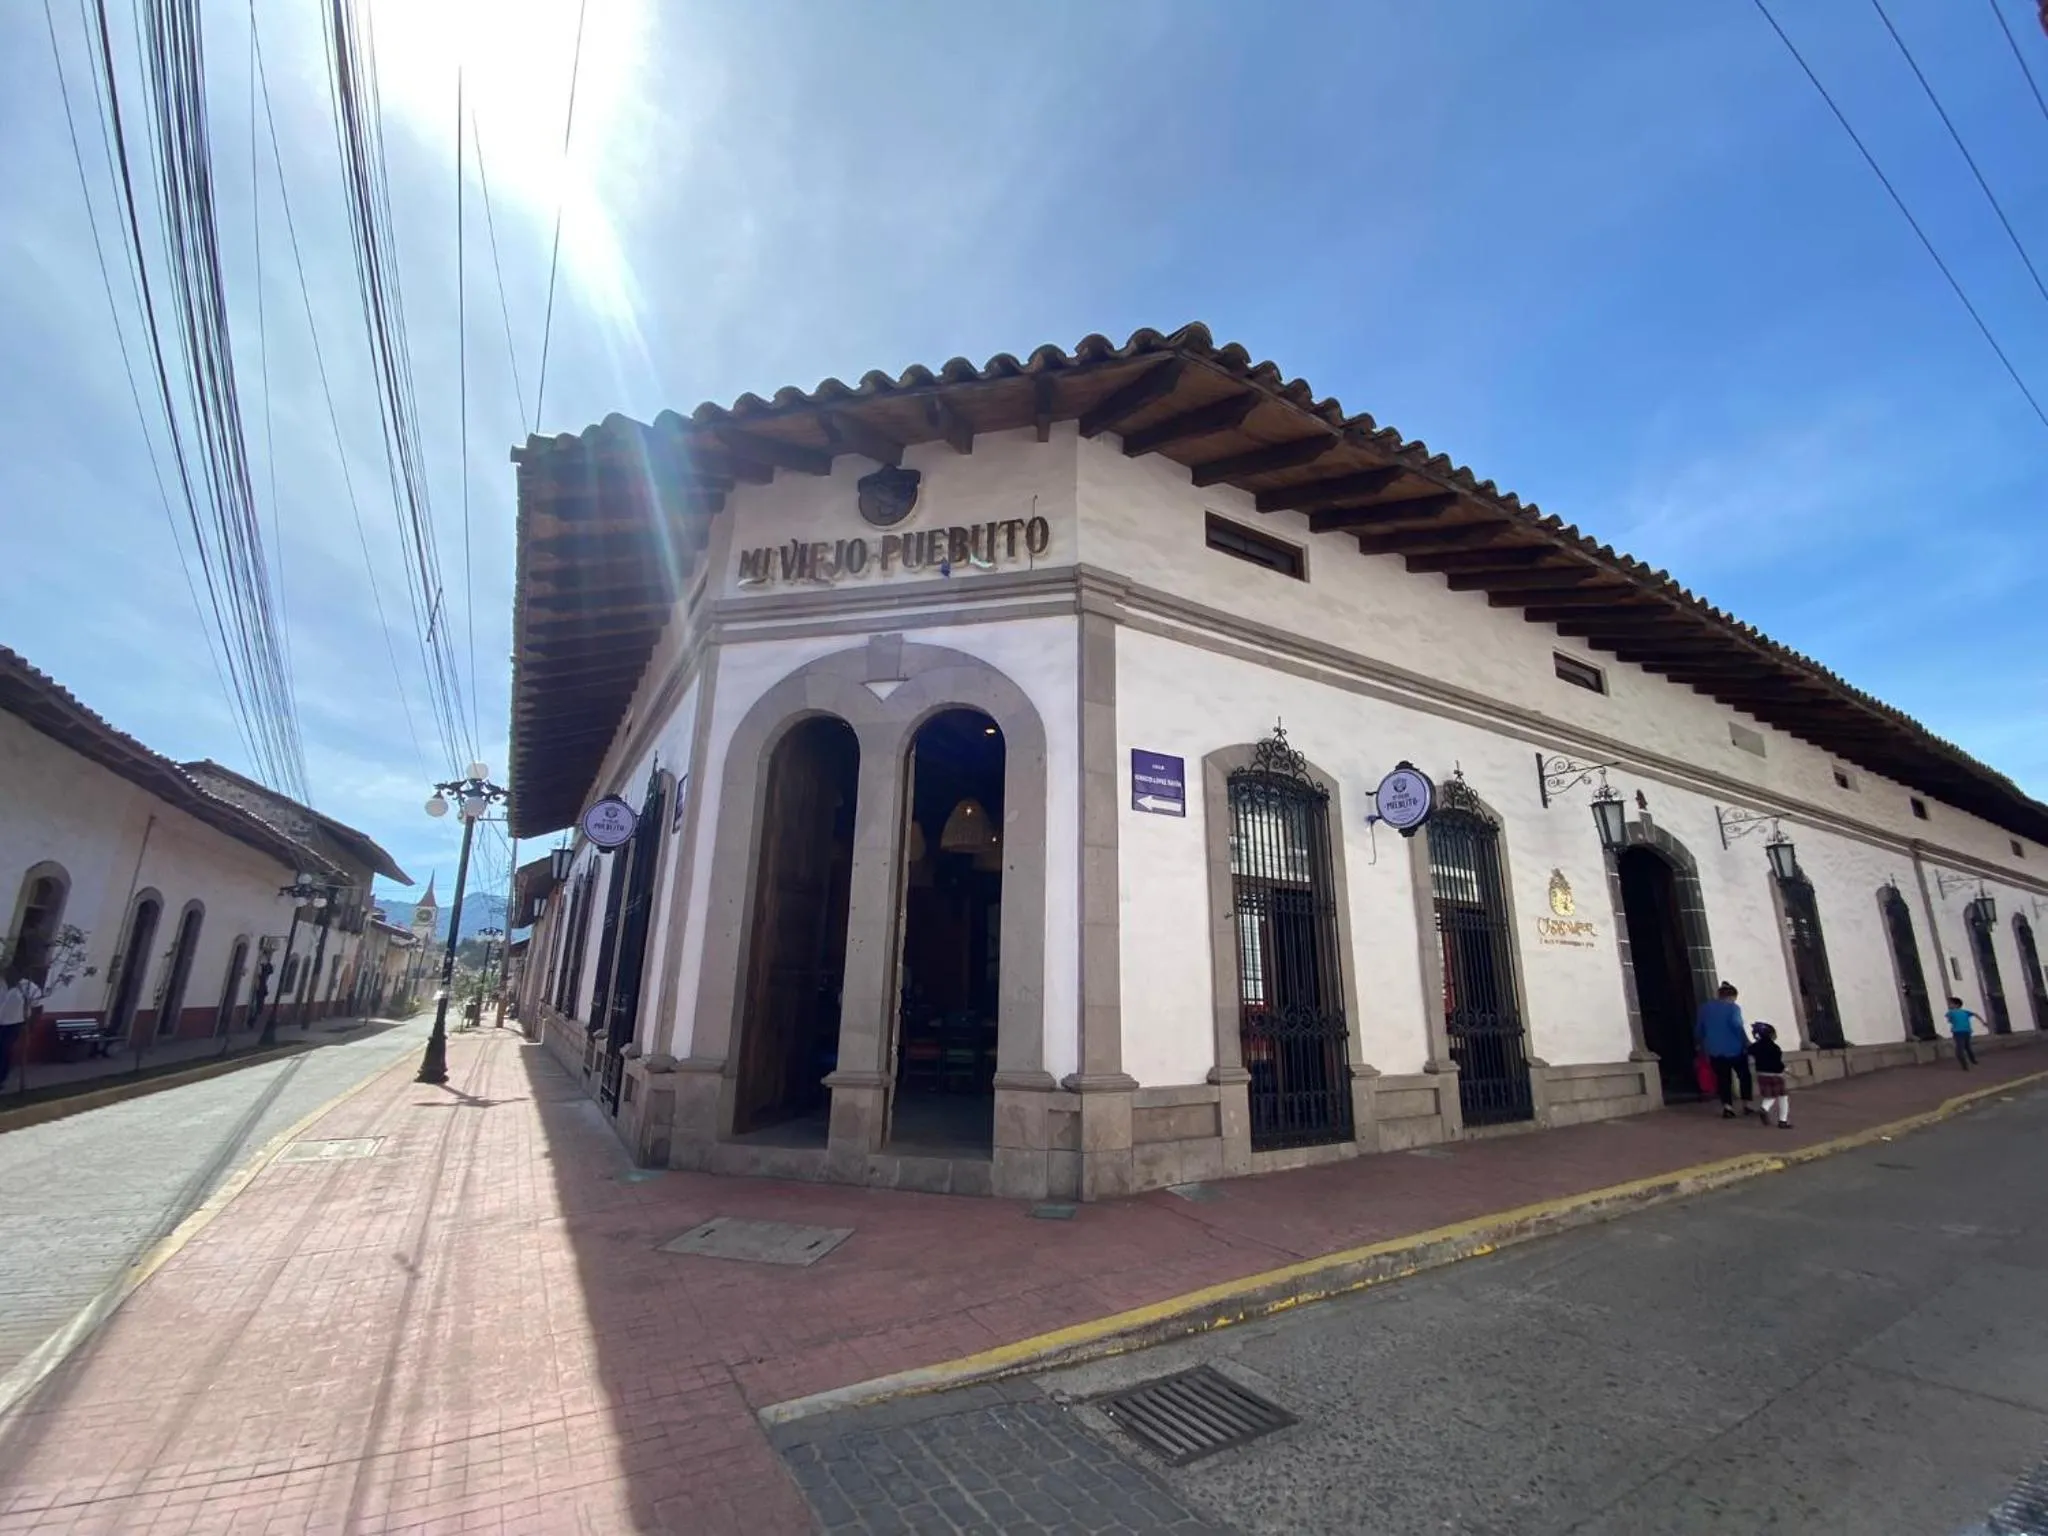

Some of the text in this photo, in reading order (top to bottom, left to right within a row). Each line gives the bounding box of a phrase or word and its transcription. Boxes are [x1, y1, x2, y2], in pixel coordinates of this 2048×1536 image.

[738, 516, 1050, 588] MI VIEJO PUEBLITO
